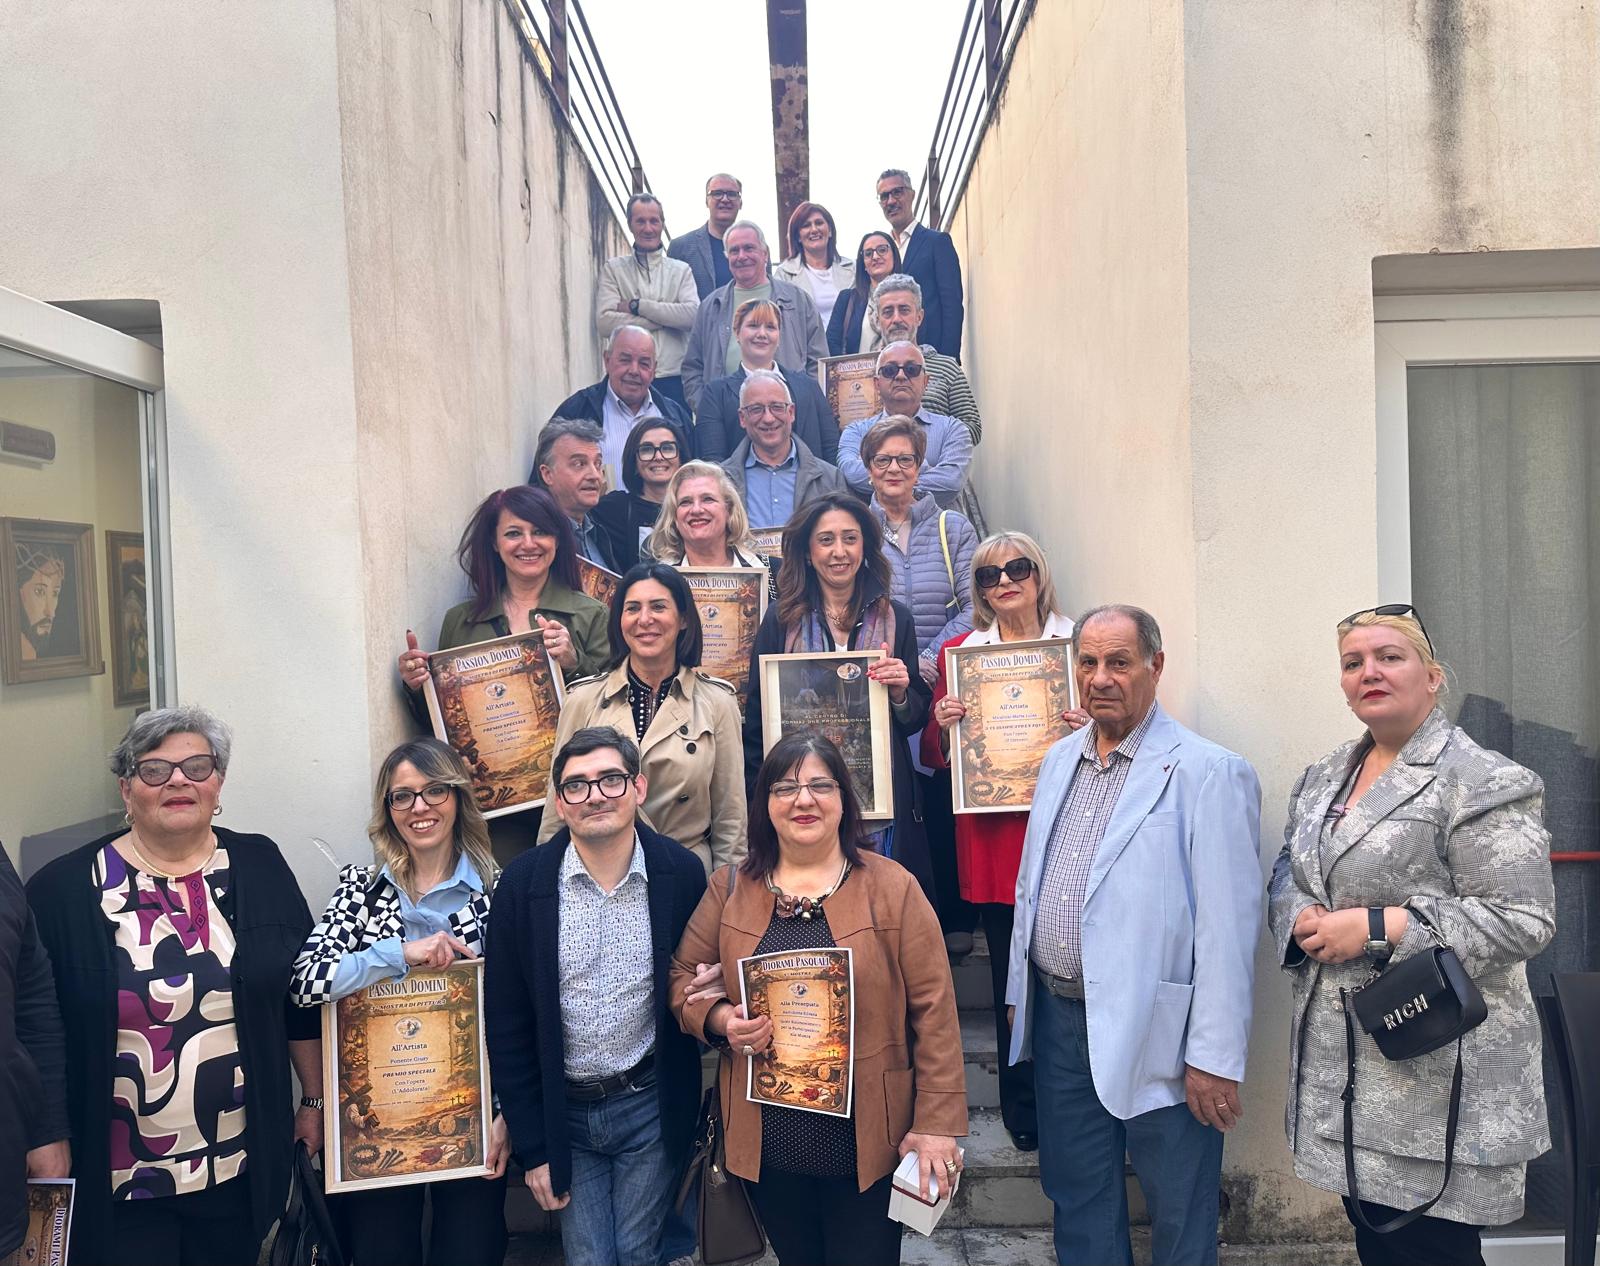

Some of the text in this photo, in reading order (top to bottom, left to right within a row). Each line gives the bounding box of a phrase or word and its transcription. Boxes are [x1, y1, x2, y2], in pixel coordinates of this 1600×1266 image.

[689, 578, 738, 588] SSION DOMINI
[456, 648, 521, 672] PASSION DOMINI
[981, 654, 1042, 669] PASSION DOMINI
[762, 956, 829, 971] DIORAMI PASQUALI
[368, 978, 446, 998] PASSION DOMINI
[1383, 993, 1429, 1031] RICH
[390, 1043, 428, 1052] All'Artista
[53, 1209, 65, 1247] DIORAMI
